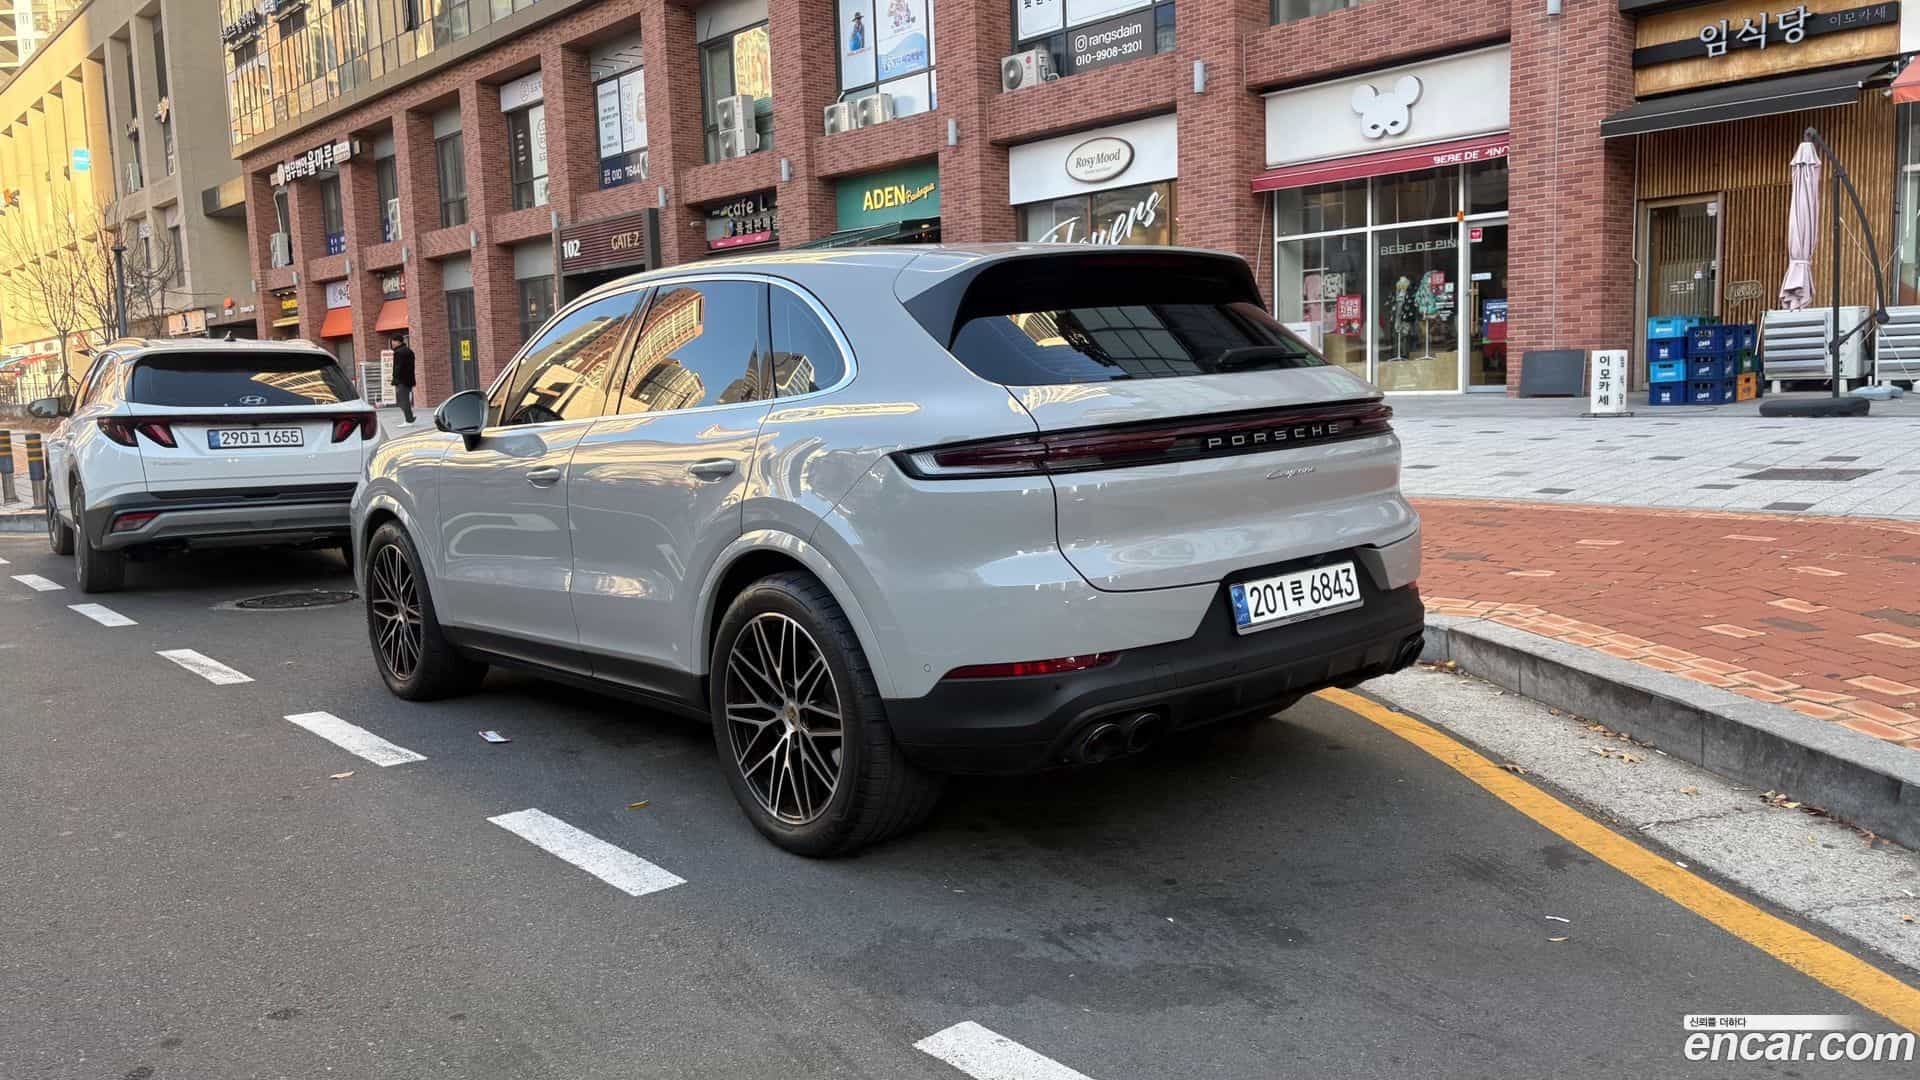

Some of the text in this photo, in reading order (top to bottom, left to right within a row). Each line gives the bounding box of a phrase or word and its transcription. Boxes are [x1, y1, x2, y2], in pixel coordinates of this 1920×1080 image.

[1089, 23, 1142, 46] rangsdaim
[1700, 5, 1887, 58] 임식당 이모카세
[1075, 40, 1142, 66] 010-9908-3201
[1075, 148, 1121, 168] Rosy Mood
[1464, 150, 1480, 160] DE
[728, 194, 767, 217] cafe L
[863, 184, 905, 211] ADEN
[562, 240, 581, 258] 102
[1381, 239, 1457, 255] BEBE DE PIN
[1598, 355, 1611, 406] 이모카세
[264, 431, 299, 444] 1655
[1208, 424, 1339, 448] PORSCHE
[1249, 568, 1354, 618] 201루 6843
